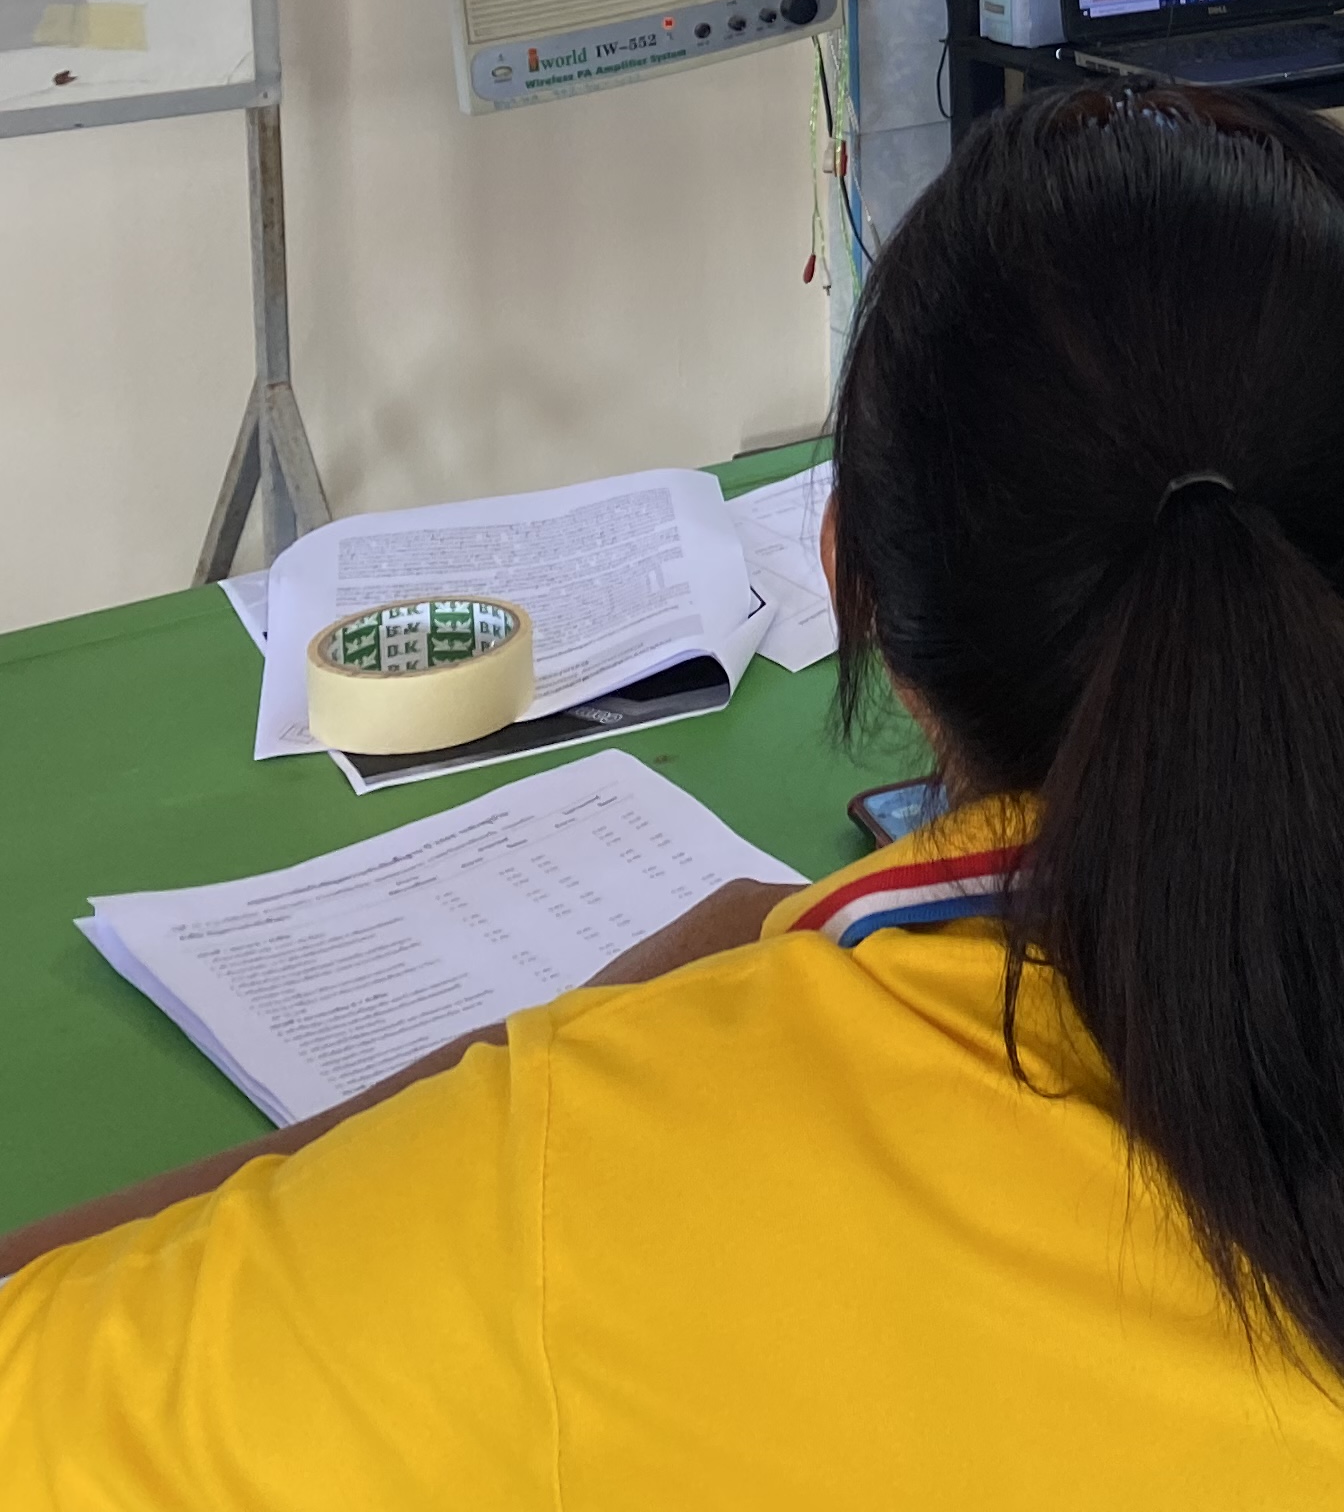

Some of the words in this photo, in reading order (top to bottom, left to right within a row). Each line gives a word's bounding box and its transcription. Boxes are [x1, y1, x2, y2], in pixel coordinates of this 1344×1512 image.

[595, 33, 657, 58] IW-552
[595, 58, 647, 75] Amplifier
[650, 49, 686, 64] System
